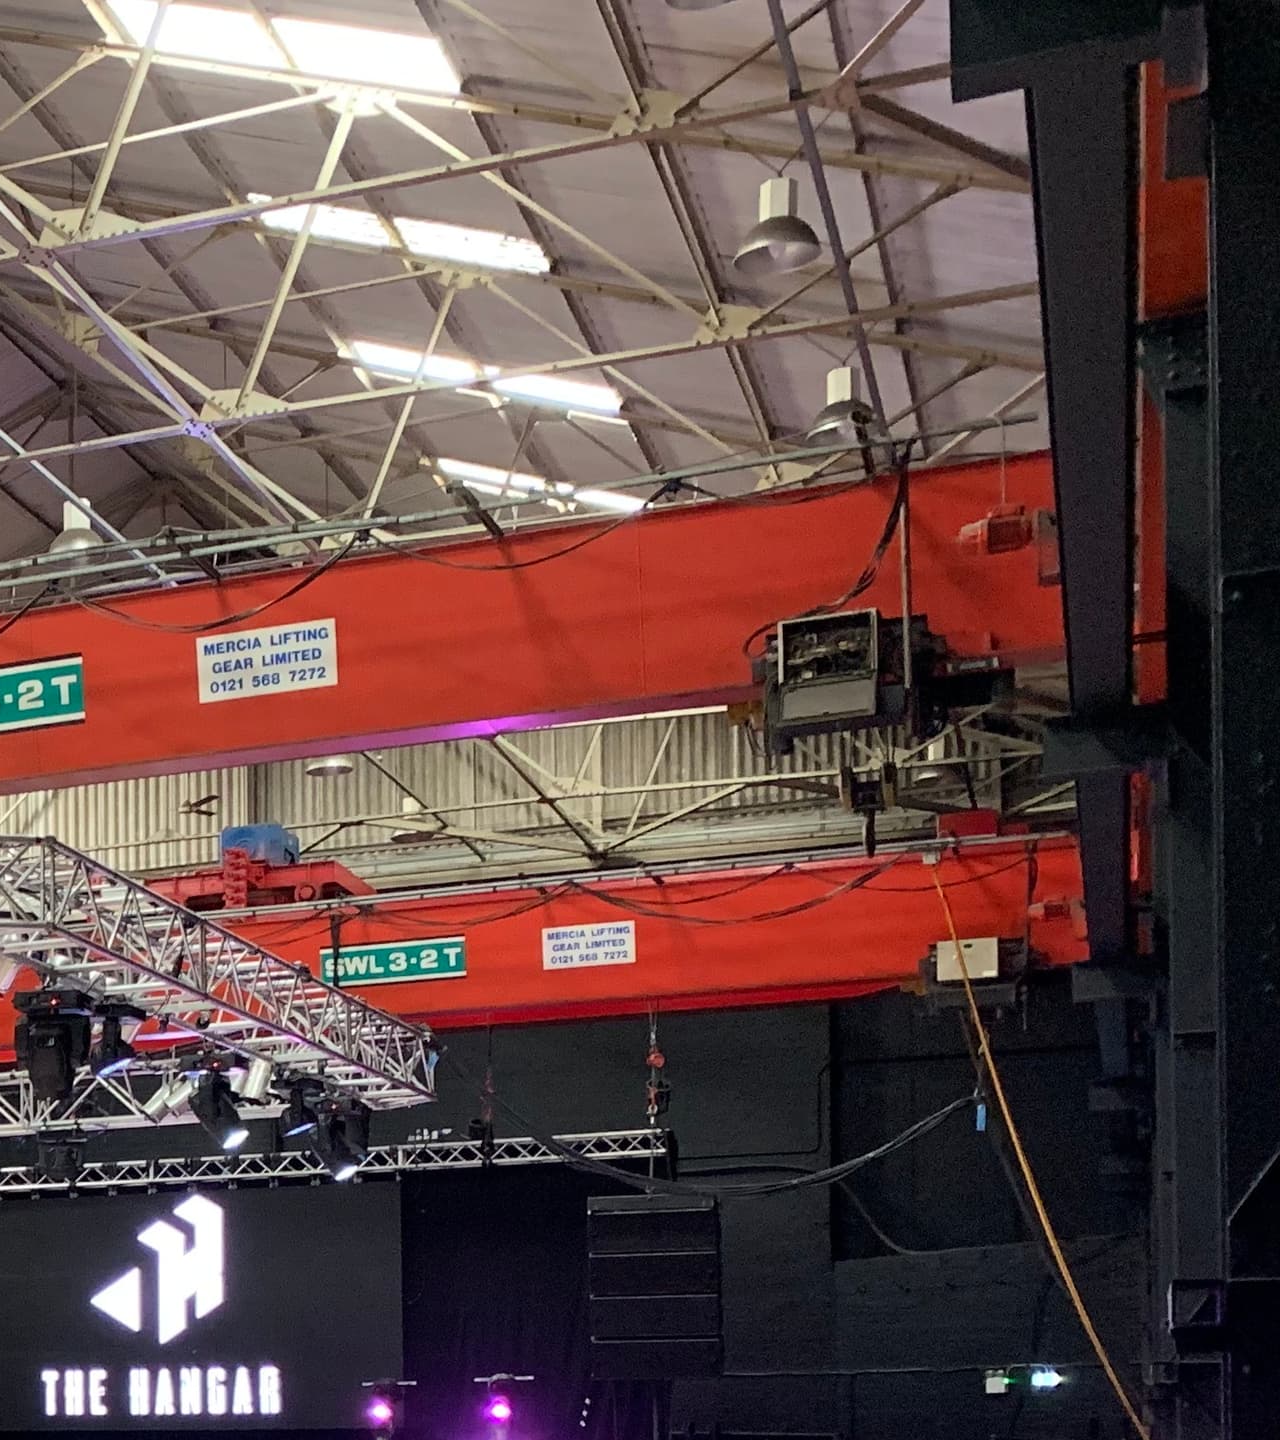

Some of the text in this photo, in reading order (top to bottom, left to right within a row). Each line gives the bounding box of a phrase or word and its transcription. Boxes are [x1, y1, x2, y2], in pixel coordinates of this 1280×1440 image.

[204, 627, 329, 656] MERCIA LIFTING
[212, 648, 322, 674] GEAR LIMITED
[50, 674, 78, 705] T
[210, 666, 327, 694] 0121 568 7272
[547, 926, 630, 940] MERCIA LIFTING
[552, 938, 626, 952] GEAR LIMITED
[325, 954, 385, 978] SWL
[443, 947, 462, 967] T
[550, 955, 574, 964] 0121
[603, 950, 628, 960] 7272
[41, 1364, 282, 1416] THE HANGAR
